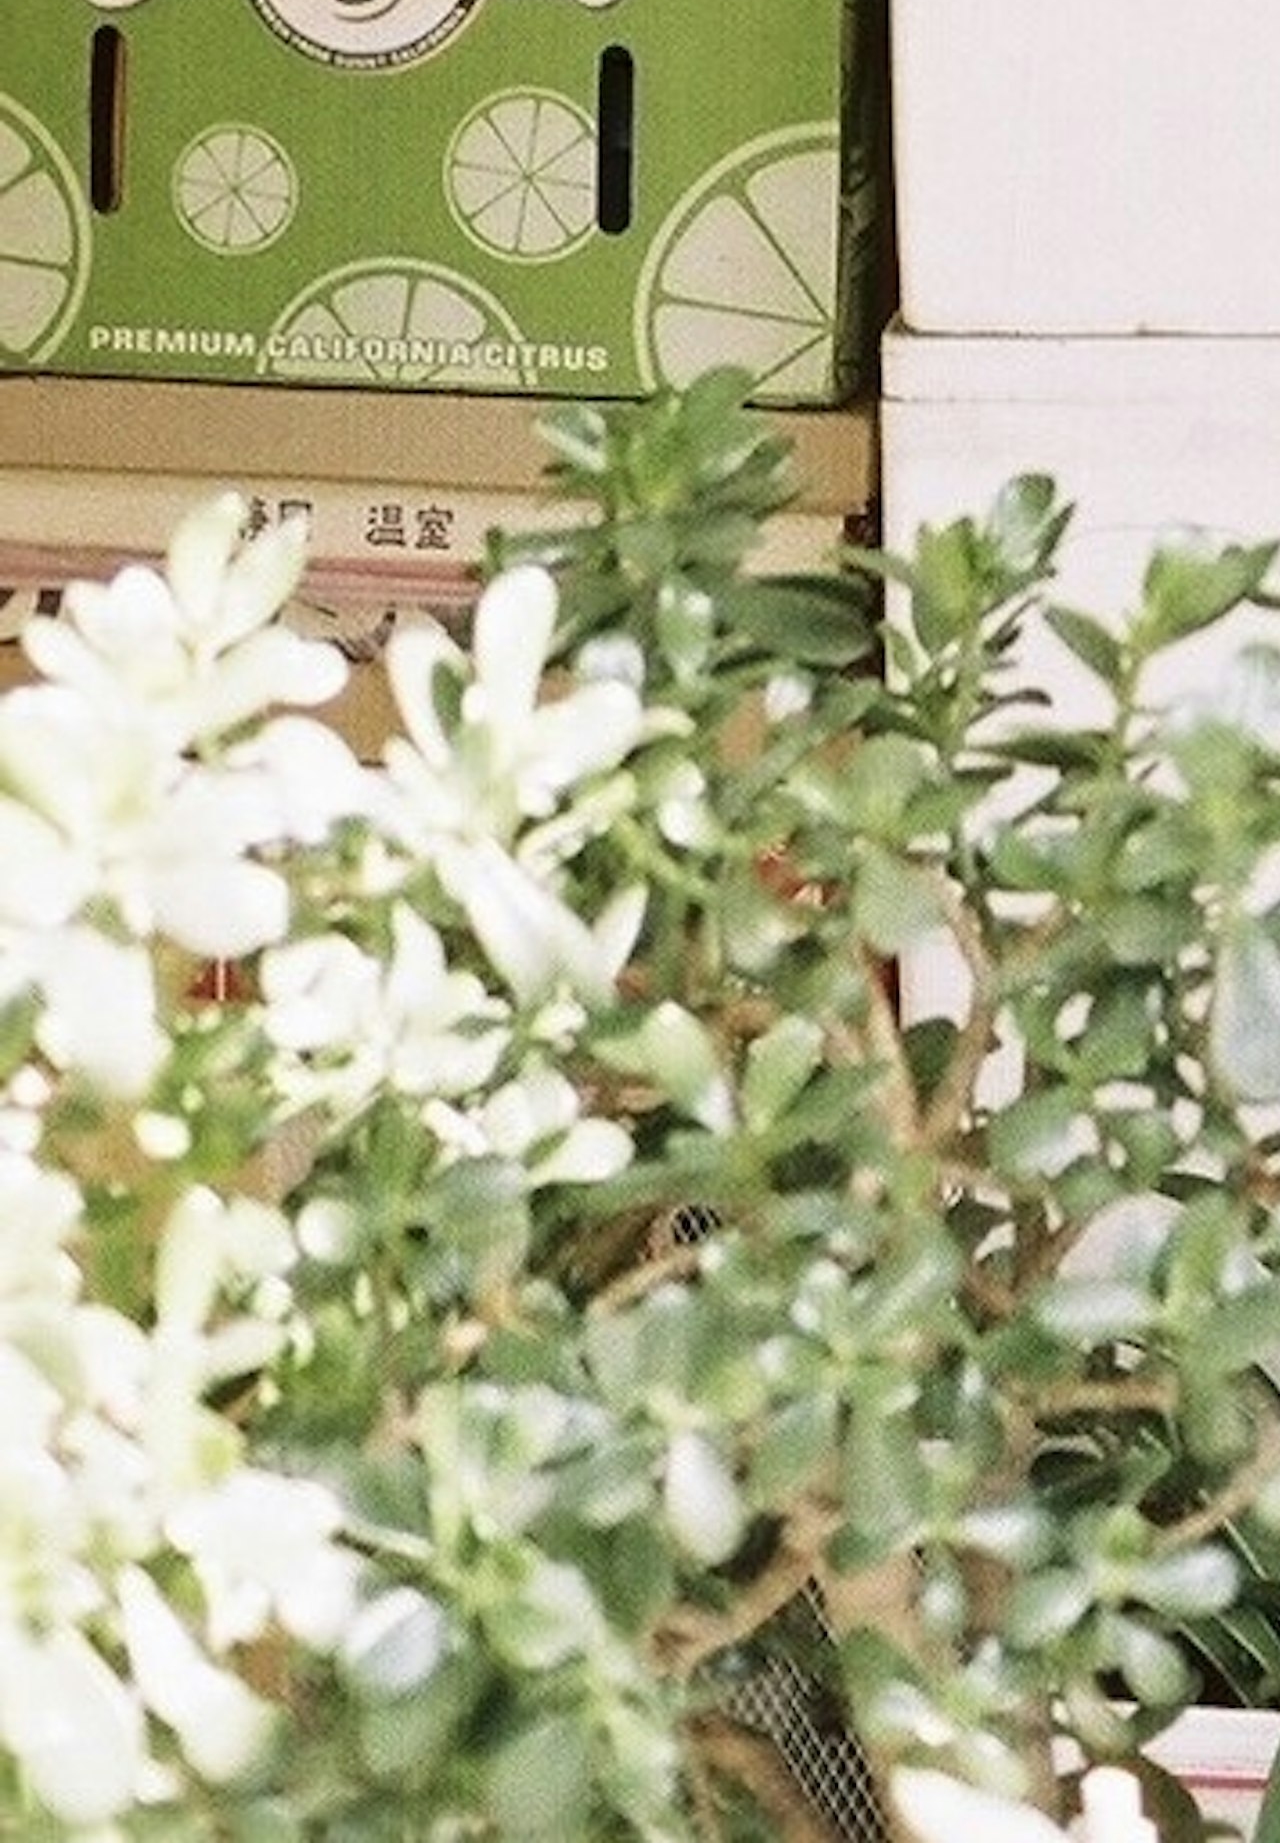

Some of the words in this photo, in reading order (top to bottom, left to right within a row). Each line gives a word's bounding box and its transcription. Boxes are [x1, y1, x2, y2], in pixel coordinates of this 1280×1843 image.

[89, 323, 256, 361] PREMIUM
[266, 332, 474, 369] CALIFORNIA
[484, 339, 609, 374] CITRUS
[364, 503, 454, 551] 温室
